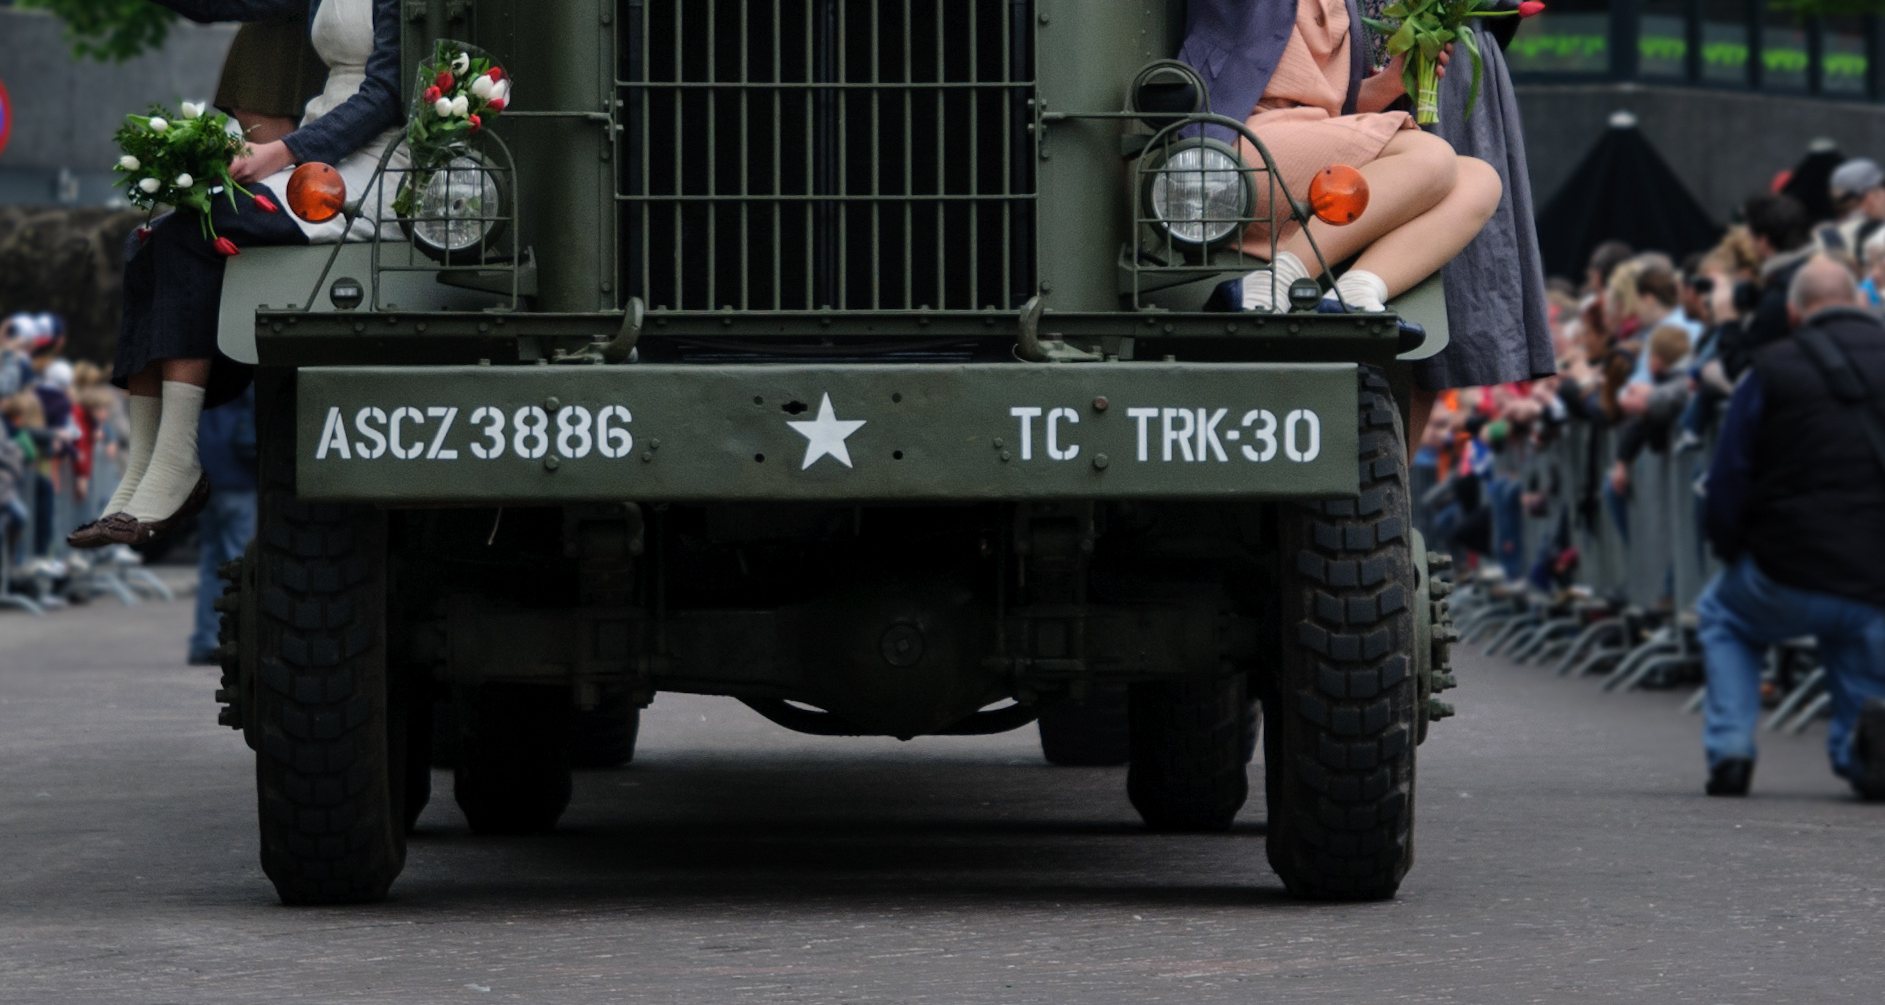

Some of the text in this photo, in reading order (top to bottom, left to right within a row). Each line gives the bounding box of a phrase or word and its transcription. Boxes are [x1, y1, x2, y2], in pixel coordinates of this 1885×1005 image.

[315, 405, 634, 460] ASCZ 3886
[1010, 406, 1321, 463] TC TRK-30
